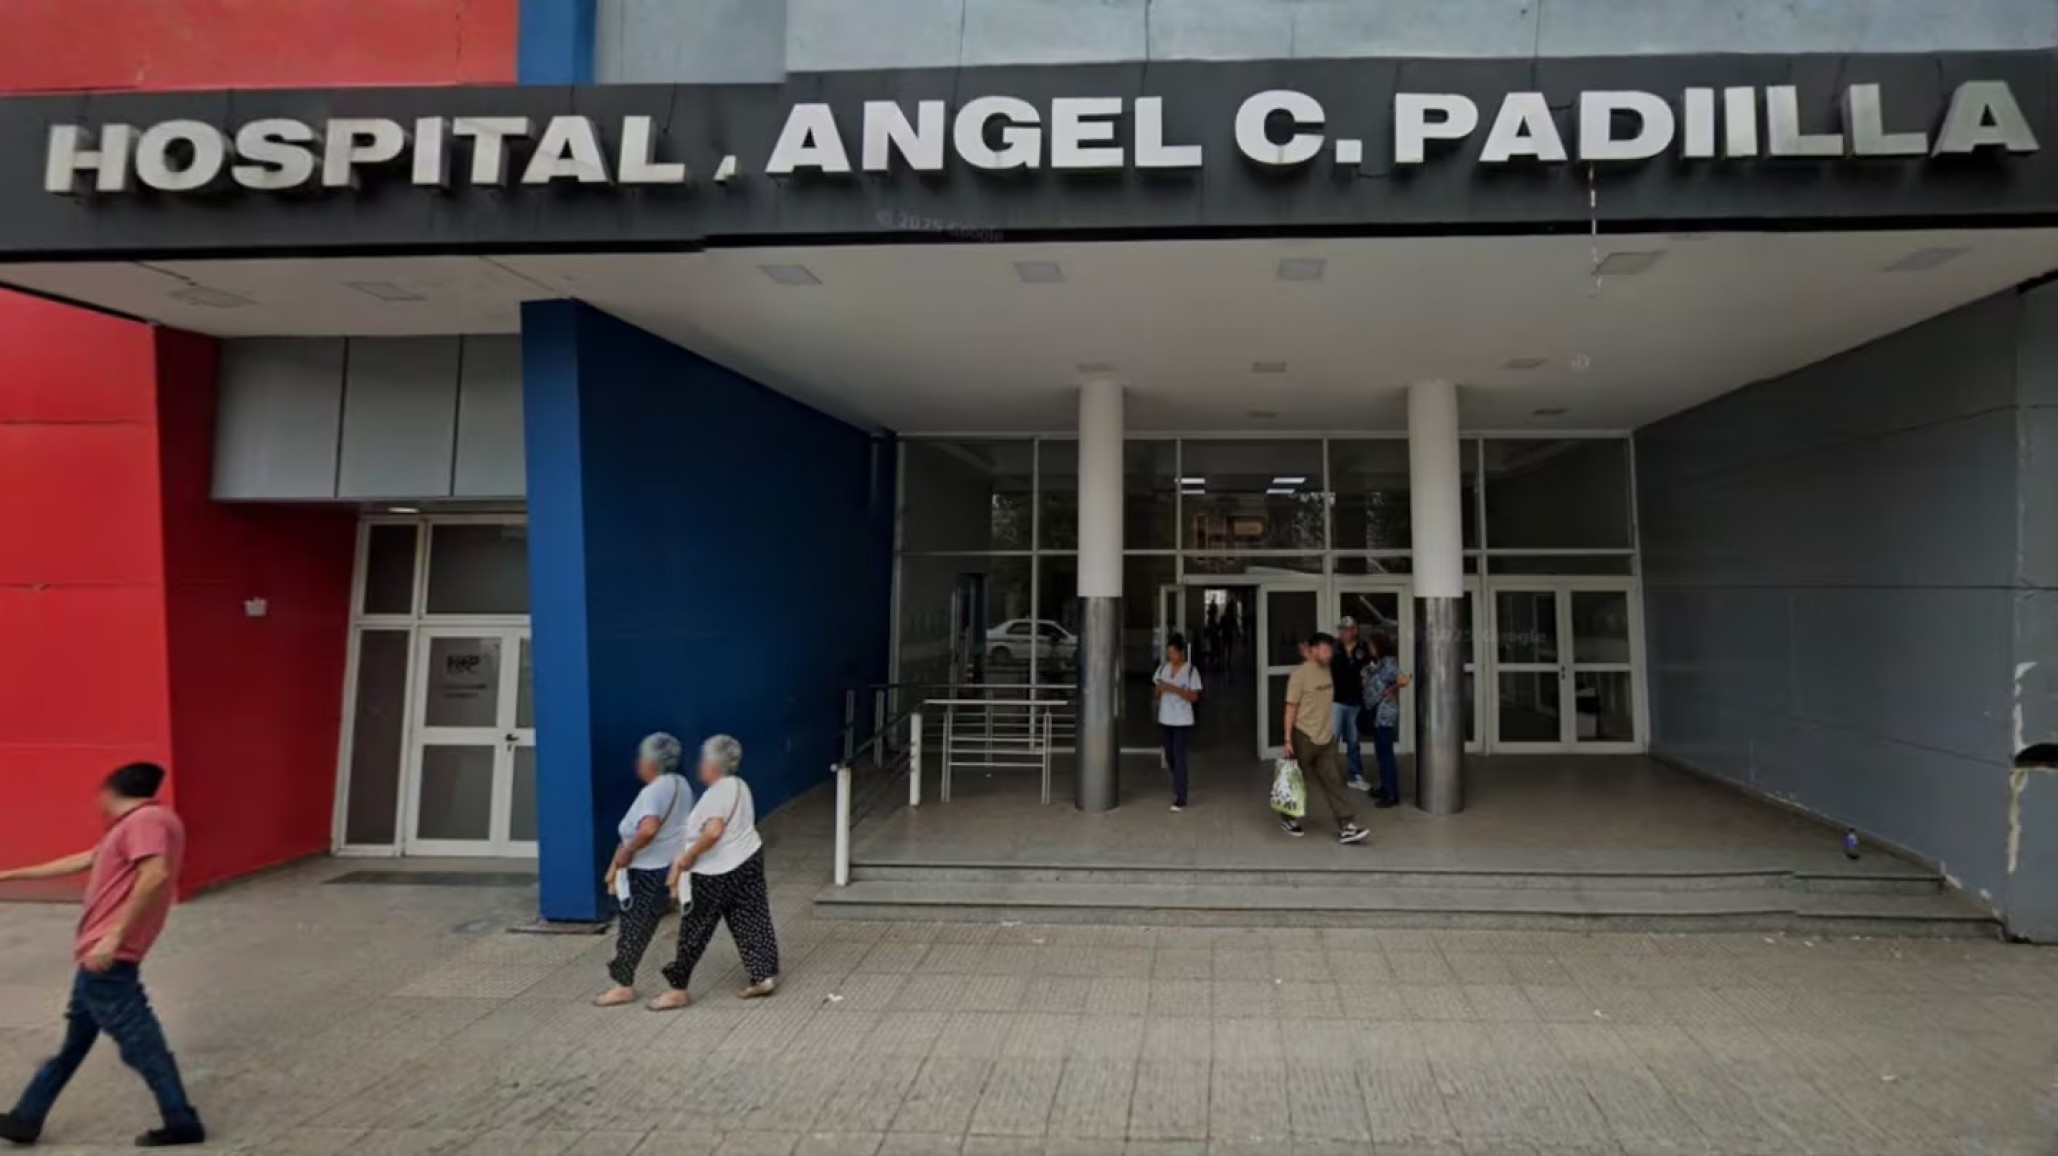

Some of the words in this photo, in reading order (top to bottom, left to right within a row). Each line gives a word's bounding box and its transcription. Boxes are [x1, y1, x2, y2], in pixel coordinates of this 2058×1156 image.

[46, 115, 687, 192] HOSPITAL
[766, 96, 1202, 173] ANGEL
[1236, 90, 1362, 164] C.
